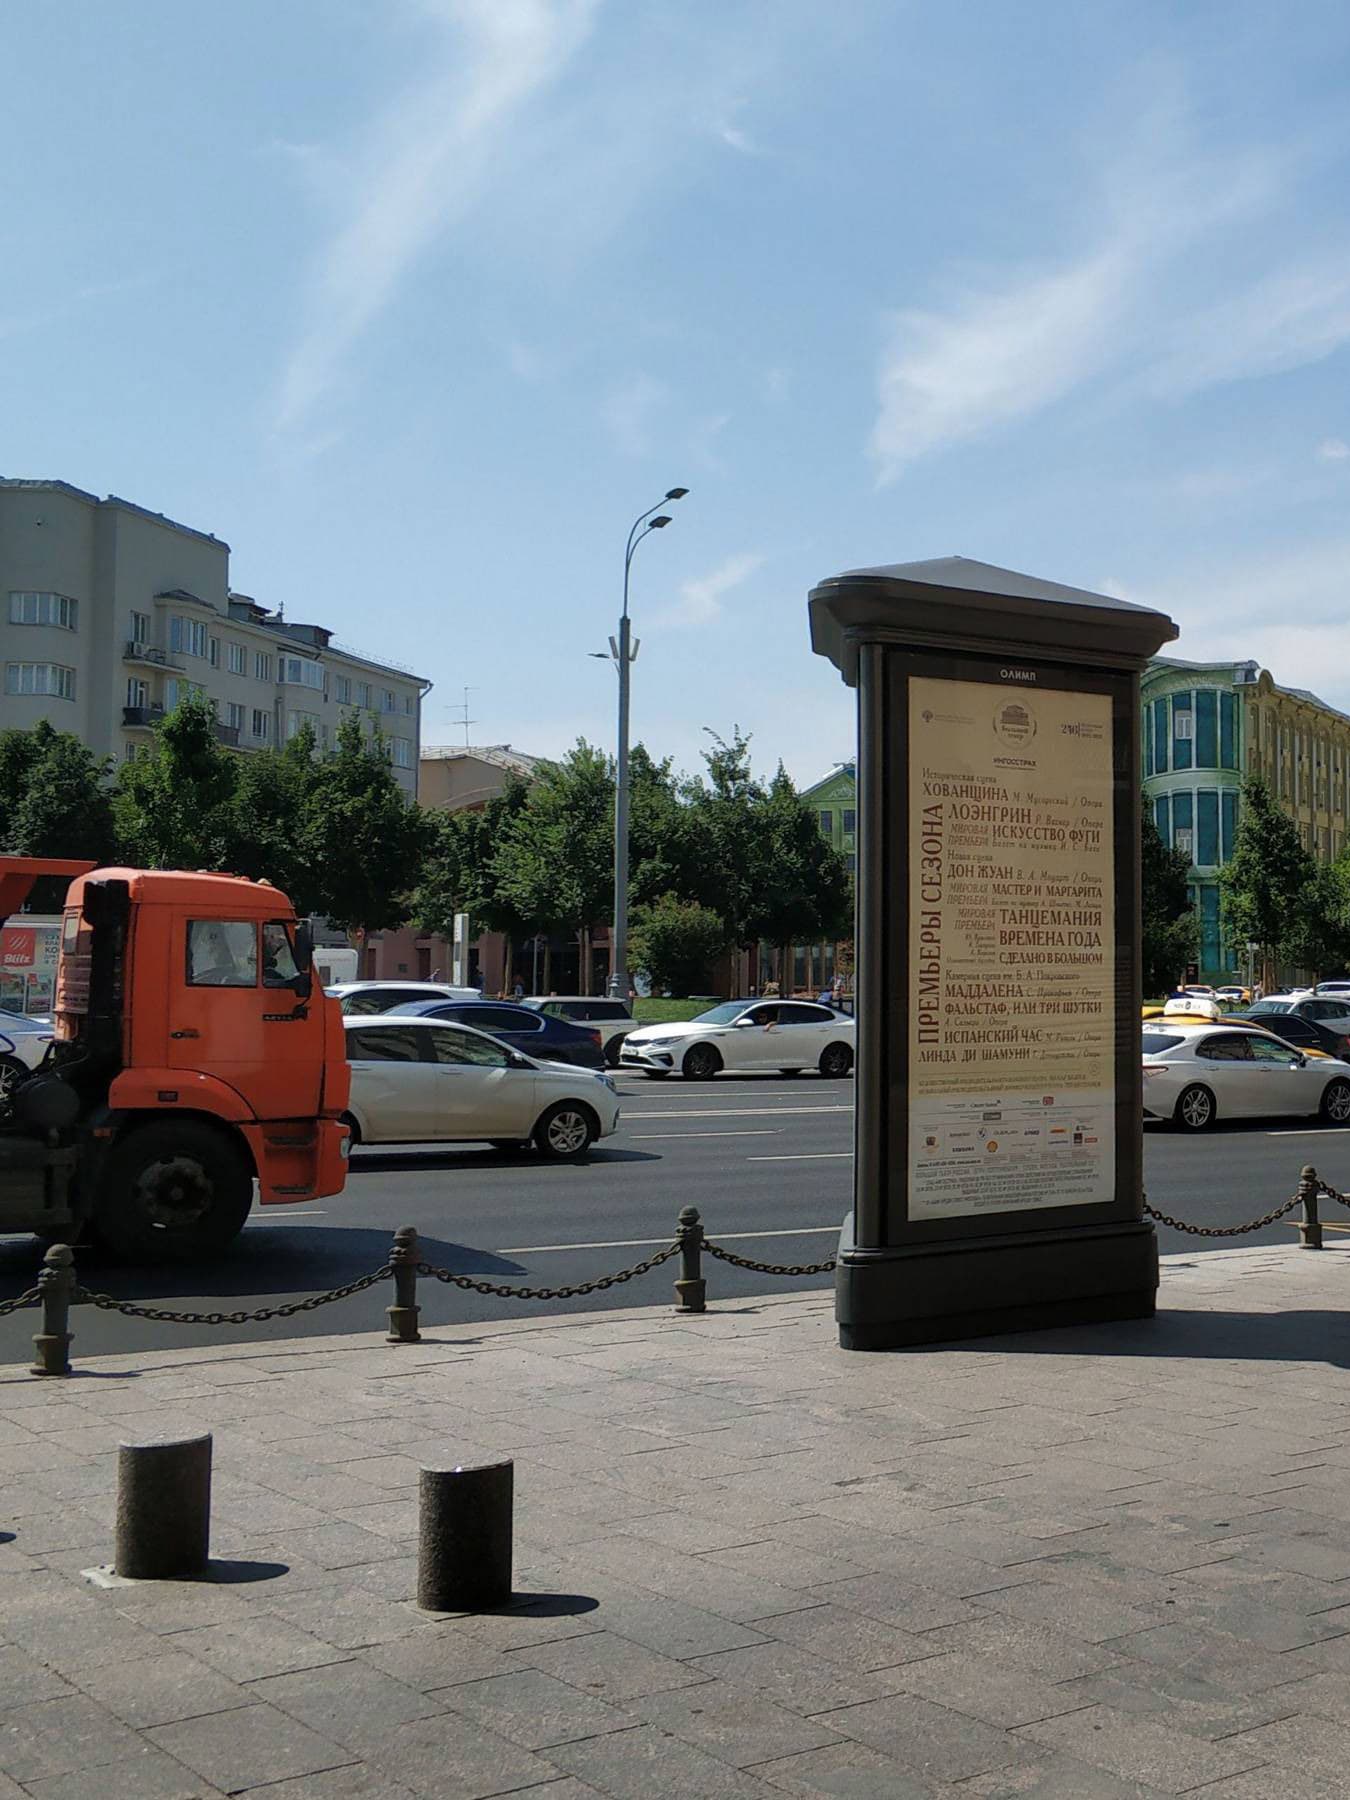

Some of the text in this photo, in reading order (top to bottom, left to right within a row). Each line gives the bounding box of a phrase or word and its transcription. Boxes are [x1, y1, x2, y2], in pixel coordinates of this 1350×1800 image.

[1000, 669, 1036, 681] ОЛИМП
[993, 757, 1037, 767] ИНГОССТРАХ
[922, 768, 975, 781] Историческая
[922, 783, 1009, 803] ХОВАНЩИНА
[948, 803, 1032, 824] ЛОЭНГРИН
[951, 823, 988, 834] МИРОВАЯ
[992, 825, 1100, 845] ИСКУССТВО ФУГИ
[948, 835, 988, 847] ПРЕМЬЕРА
[947, 850, 993, 863] Новая сцена
[948, 864, 975, 879] ДОН
[978, 865, 1013, 880] ЖУАН
[950, 883, 988, 893] МИРОВАЯ
[992, 884, 1103, 898] МАСТЕР И МАРГАРИТА
[947, 895, 988, 905] ПРЕМЬЕРА
[959, 909, 996, 918] МИРОВАЯ
[1000, 909, 1102, 929] ТАНЦЕМАНИЯ
[918, 803, 944, 1044] ПРЕМЬЕРЫ СЕЗОНА
[954, 920, 996, 930] ПРЕМЬЕРА
[1000, 930, 1065, 946] ВРЕМЕНА
[1067, 931, 1102, 949] ГОДА
[4, 953, 31, 963] Blitz
[1000, 952, 1045, 964] СДЕЛАНО
[1047, 953, 1054, 963] В
[1054, 953, 1103, 964] БОЛЬШОМ
[945, 970, 980, 982] Камерная
[945, 984, 1024, 999] МАДДАЛЕНА
[944, 1002, 1102, 1016] ФАЛЬСТАФ, ИЛИ ТРИ ШУТКИ
[944, 1025, 1019, 1044] ИСПАНСКИЙ
[1021, 1029, 1043, 1042] ЧАС
[918, 1050, 957, 1063] ЛИНДА
[962, 1049, 977, 1062] ДИ
[982, 1047, 1030, 1060] ШАМУНИ
